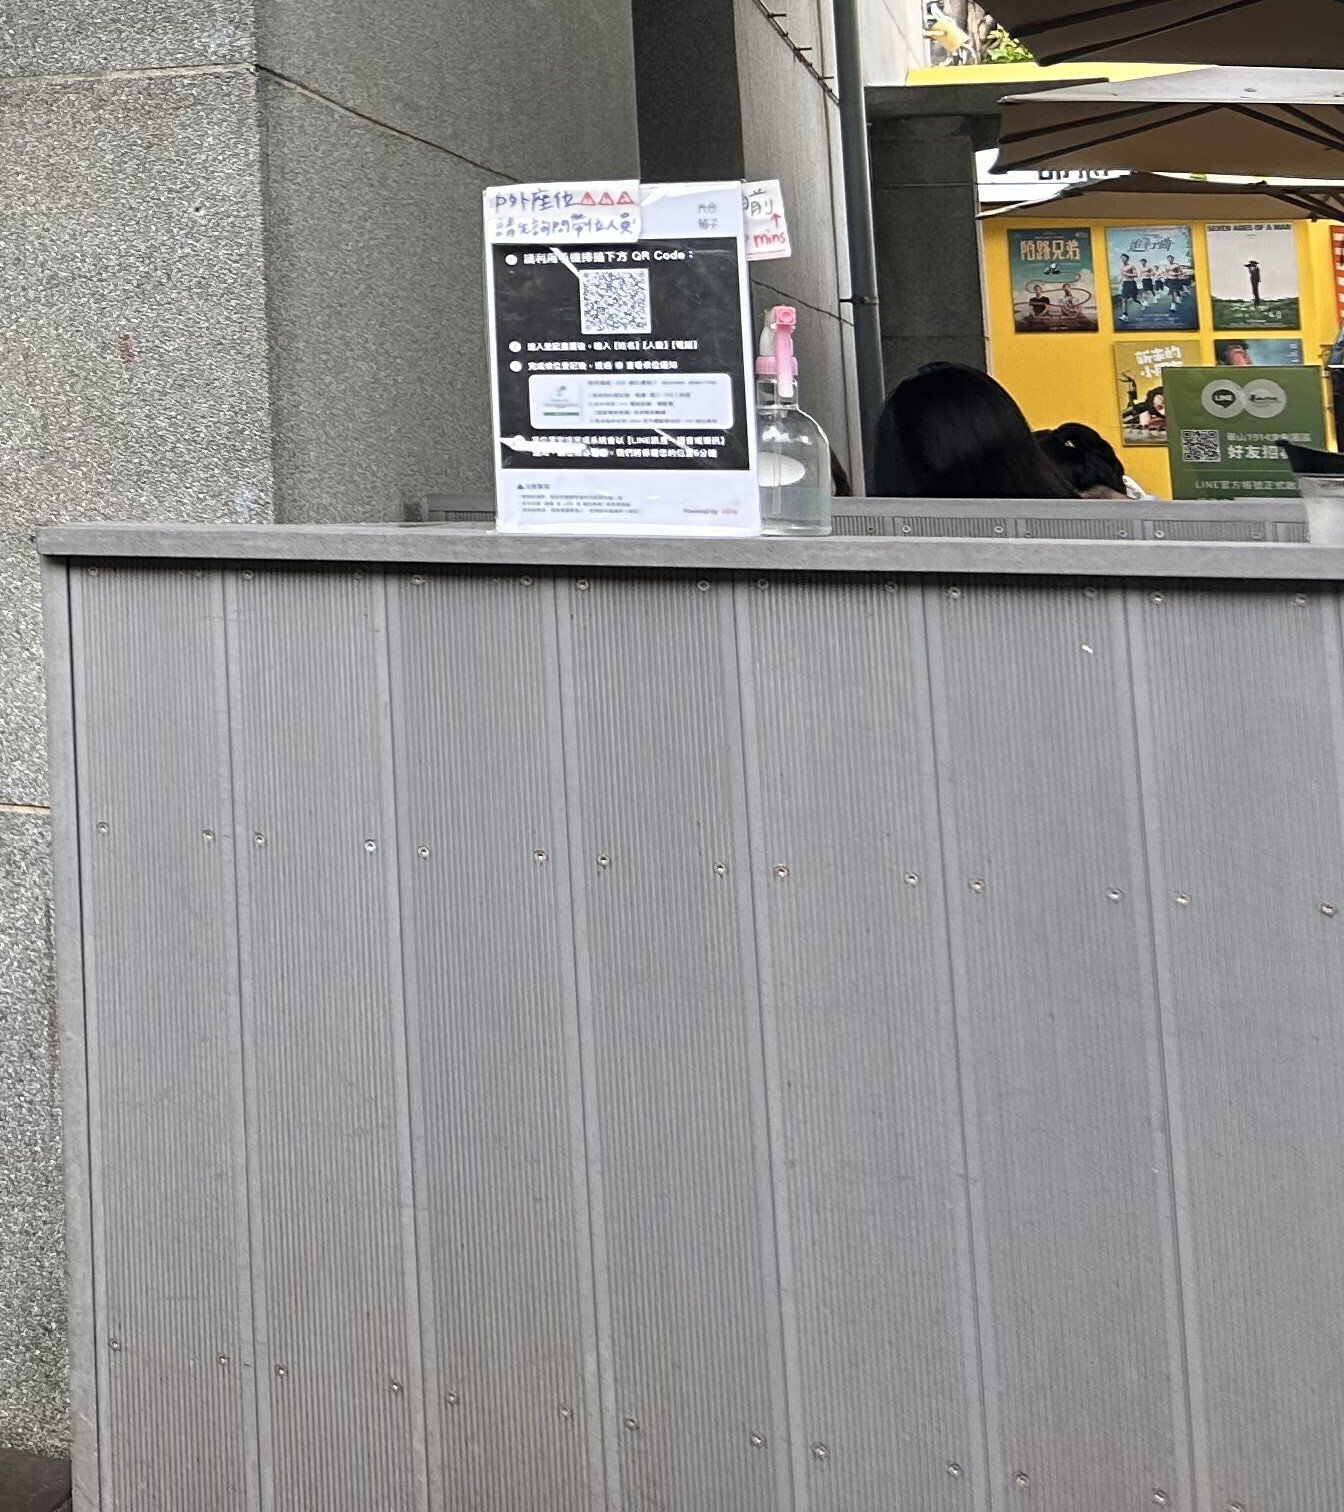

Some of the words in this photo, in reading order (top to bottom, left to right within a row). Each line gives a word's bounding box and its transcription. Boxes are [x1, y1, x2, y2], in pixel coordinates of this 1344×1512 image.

[753, 232, 786, 248] mins
[631, 251, 650, 261] QR
[1020, 239, 1081, 261] 陌路兄弟
